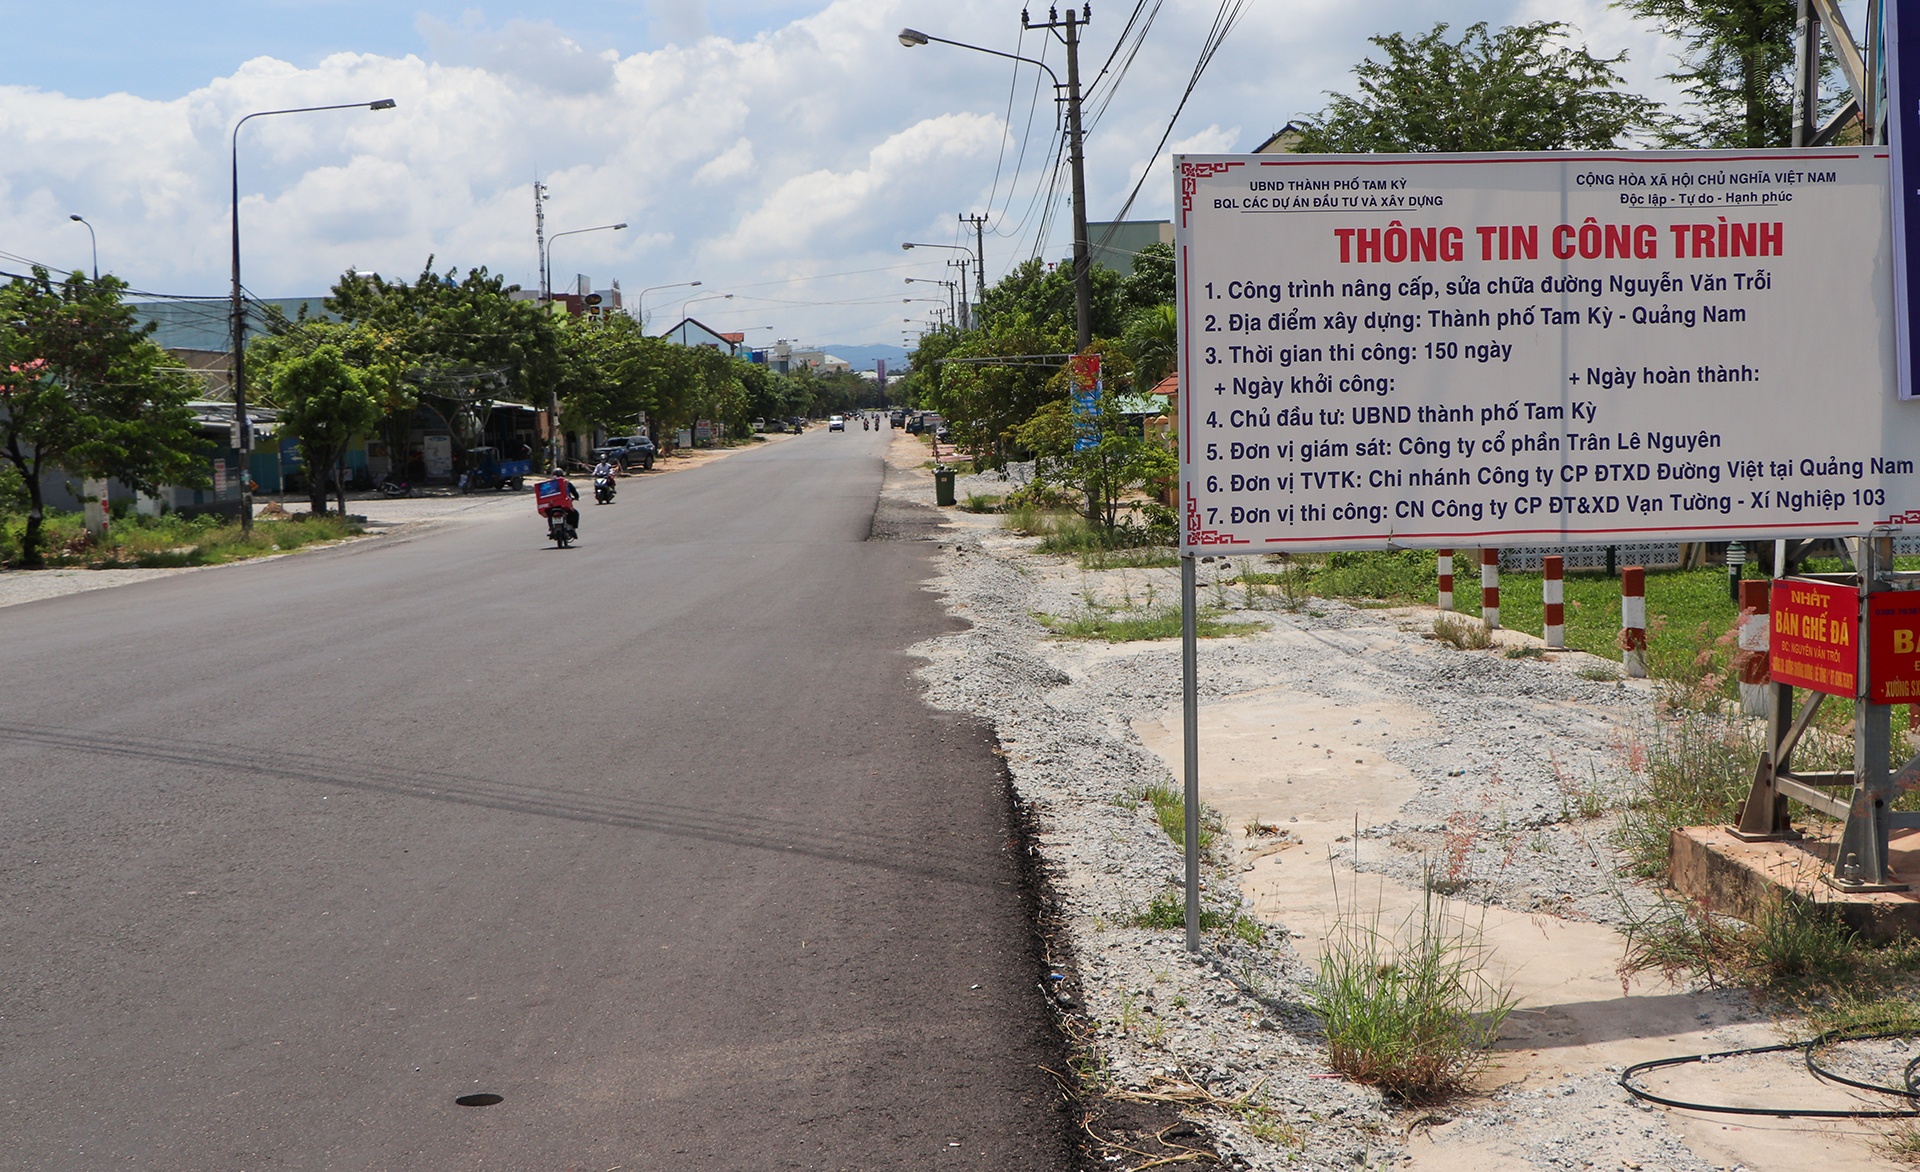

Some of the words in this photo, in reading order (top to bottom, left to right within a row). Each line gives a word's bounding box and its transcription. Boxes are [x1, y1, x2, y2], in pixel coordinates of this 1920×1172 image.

[1249, 181, 1285, 192] UBND
[1287, 178, 1330, 191] THÀNH
[1333, 176, 1360, 191] PHỐ
[1361, 180, 1387, 190] TAM
[1390, 177, 1407, 190] KỲ
[1576, 171, 1615, 188] CỘNG
[1618, 172, 1647, 186] HÒA
[1650, 172, 1668, 186] XÃ
[1671, 172, 1694, 188] HỘI
[1697, 170, 1726, 186] CHỦ
[1729, 170, 1771, 185] NGHĨA
[1774, 169, 1804, 186] VIỆT
[1807, 171, 1836, 183] NAM
[1213, 198, 1240, 209] BQL
[1242, 195, 1269, 209] CÁC
[1272, 196, 1291, 210] DỰ
[1292, 195, 1310, 208] ÁN
[1312, 193, 1339, 208] ĐẦU
[1341, 195, 1359, 208] TƯ
[1360, 194, 1378, 207] VÀ
[1380, 194, 1405, 207] XÂY
[1408, 194, 1443, 209] DỰNG
[1619, 193, 1645, 207] Độc
[1648, 193, 1668, 207] lập
[1678, 193, 1696, 207] Tự
[1697, 192, 1715, 204] do
[1725, 191, 1758, 203] Hạnh
[1761, 190, 1793, 205] phúc
[1333, 219, 1464, 264] THÔNG
[1475, 225, 1538, 261] TIN
[1552, 216, 1657, 260] CÔNG
[1669, 215, 1783, 259] TRÌNH
[1204, 281, 1222, 300] 1.
[1228, 280, 1281, 304] Công
[1287, 279, 1335, 298] trình
[1342, 278, 1391, 302] nâng
[1398, 275, 1439, 301] cấp,
[1445, 274, 1481, 296] sửa
[1486, 275, 1535, 295] chữa
[1540, 274, 1603, 298] đường
[1609, 271, 1683, 298] Nguyễn
[1689, 273, 1727, 292] Văn
[1733, 268, 1771, 291] Trỗi
[1204, 314, 1222, 332] 2.
[1228, 313, 1262, 336] Địa
[1267, 307, 1316, 331] điểm
[1323, 311, 1358, 334] xây
[1364, 311, 1421, 333] dựng:
[1427, 308, 1490, 328] Thành
[1497, 304, 1536, 331] phố
[1540, 307, 1580, 325] Tam
[1588, 305, 1614, 329] Kỳ
[1632, 303, 1696, 328] Quảng
[1703, 305, 1746, 323] Nam
[1205, 346, 1223, 365] 3.
[1228, 344, 1273, 364] Thời
[1279, 344, 1322, 368] gian
[1328, 343, 1355, 362] thi
[1361, 342, 1417, 365] công:
[1424, 341, 1458, 360] 150
[1464, 339, 1513, 363] ngày
[1233, 375, 1284, 400] Ngày
[1290, 372, 1333, 394] khởi
[1339, 373, 1395, 397] công:
[1587, 366, 1637, 390] Ngày
[1643, 365, 1691, 385] hoàn
[1696, 364, 1759, 383] thành:
[1206, 410, 1223, 429] 4.
[1230, 406, 1271, 429] Chủ
[1276, 405, 1313, 427] đầu
[1318, 408, 1345, 426] tư:
[1352, 405, 1412, 425] UBND
[1417, 404, 1474, 423] thành
[1481, 399, 1520, 427] phố
[1523, 402, 1564, 420] Tam
[1571, 400, 1597, 424] Kỳ
[1206, 443, 1224, 461] 5.
[1230, 442, 1270, 460] Đơn
[1276, 440, 1294, 462] vị
[1300, 438, 1349, 463] giám
[1355, 437, 1392, 457] sát:
[1398, 436, 1451, 459] Công
[1456, 437, 1476, 459] ty
[1481, 429, 1506, 453] cổ
[1511, 430, 1560, 457] phần
[1566, 432, 1610, 451] Trân
[1617, 431, 1641, 450] Lê
[1647, 430, 1721, 454] Nguyên
[1206, 475, 1224, 494] 6.
[1230, 474, 1270, 492] Đơn
[1276, 472, 1294, 494] vị
[1300, 470, 1362, 490] TVTK:
[1368, 469, 1402, 488] Chi
[1409, 467, 1470, 487] nhánh
[1477, 465, 1529, 488] Công
[1535, 466, 1554, 488] ty
[1560, 464, 1589, 483] CP
[1594, 463, 1651, 482] ĐTXD
[1656, 461, 1720, 484] Đường
[1726, 459, 1764, 482] Việt
[1769, 459, 1793, 477] tại
[1799, 455, 1864, 480] Quảng
[1870, 456, 1914, 475] Nam
[1206, 507, 1224, 525] 7.
[1230, 506, 1270, 524] Đơn
[1277, 504, 1294, 526] vị
[1300, 503, 1326, 522] thi
[1332, 501, 1388, 524] công:
[1395, 500, 1424, 519] CN
[1431, 499, 1483, 522] Công
[1489, 499, 1508, 520] ty
[1514, 496, 1543, 515] CP
[1548, 495, 1620, 515] ĐT&XD
[1626, 494, 1663, 516] Vạn
[1669, 492, 1731, 515] Tường
[1750, 490, 1771, 509] Xí
[1776, 488, 1846, 513] Nghiệp
[1852, 488, 1886, 506] 103
[1775, 607, 1799, 637] BÁN
[1802, 611, 1828, 642] GHẾ
[1830, 617, 1849, 646] ĐÁ
